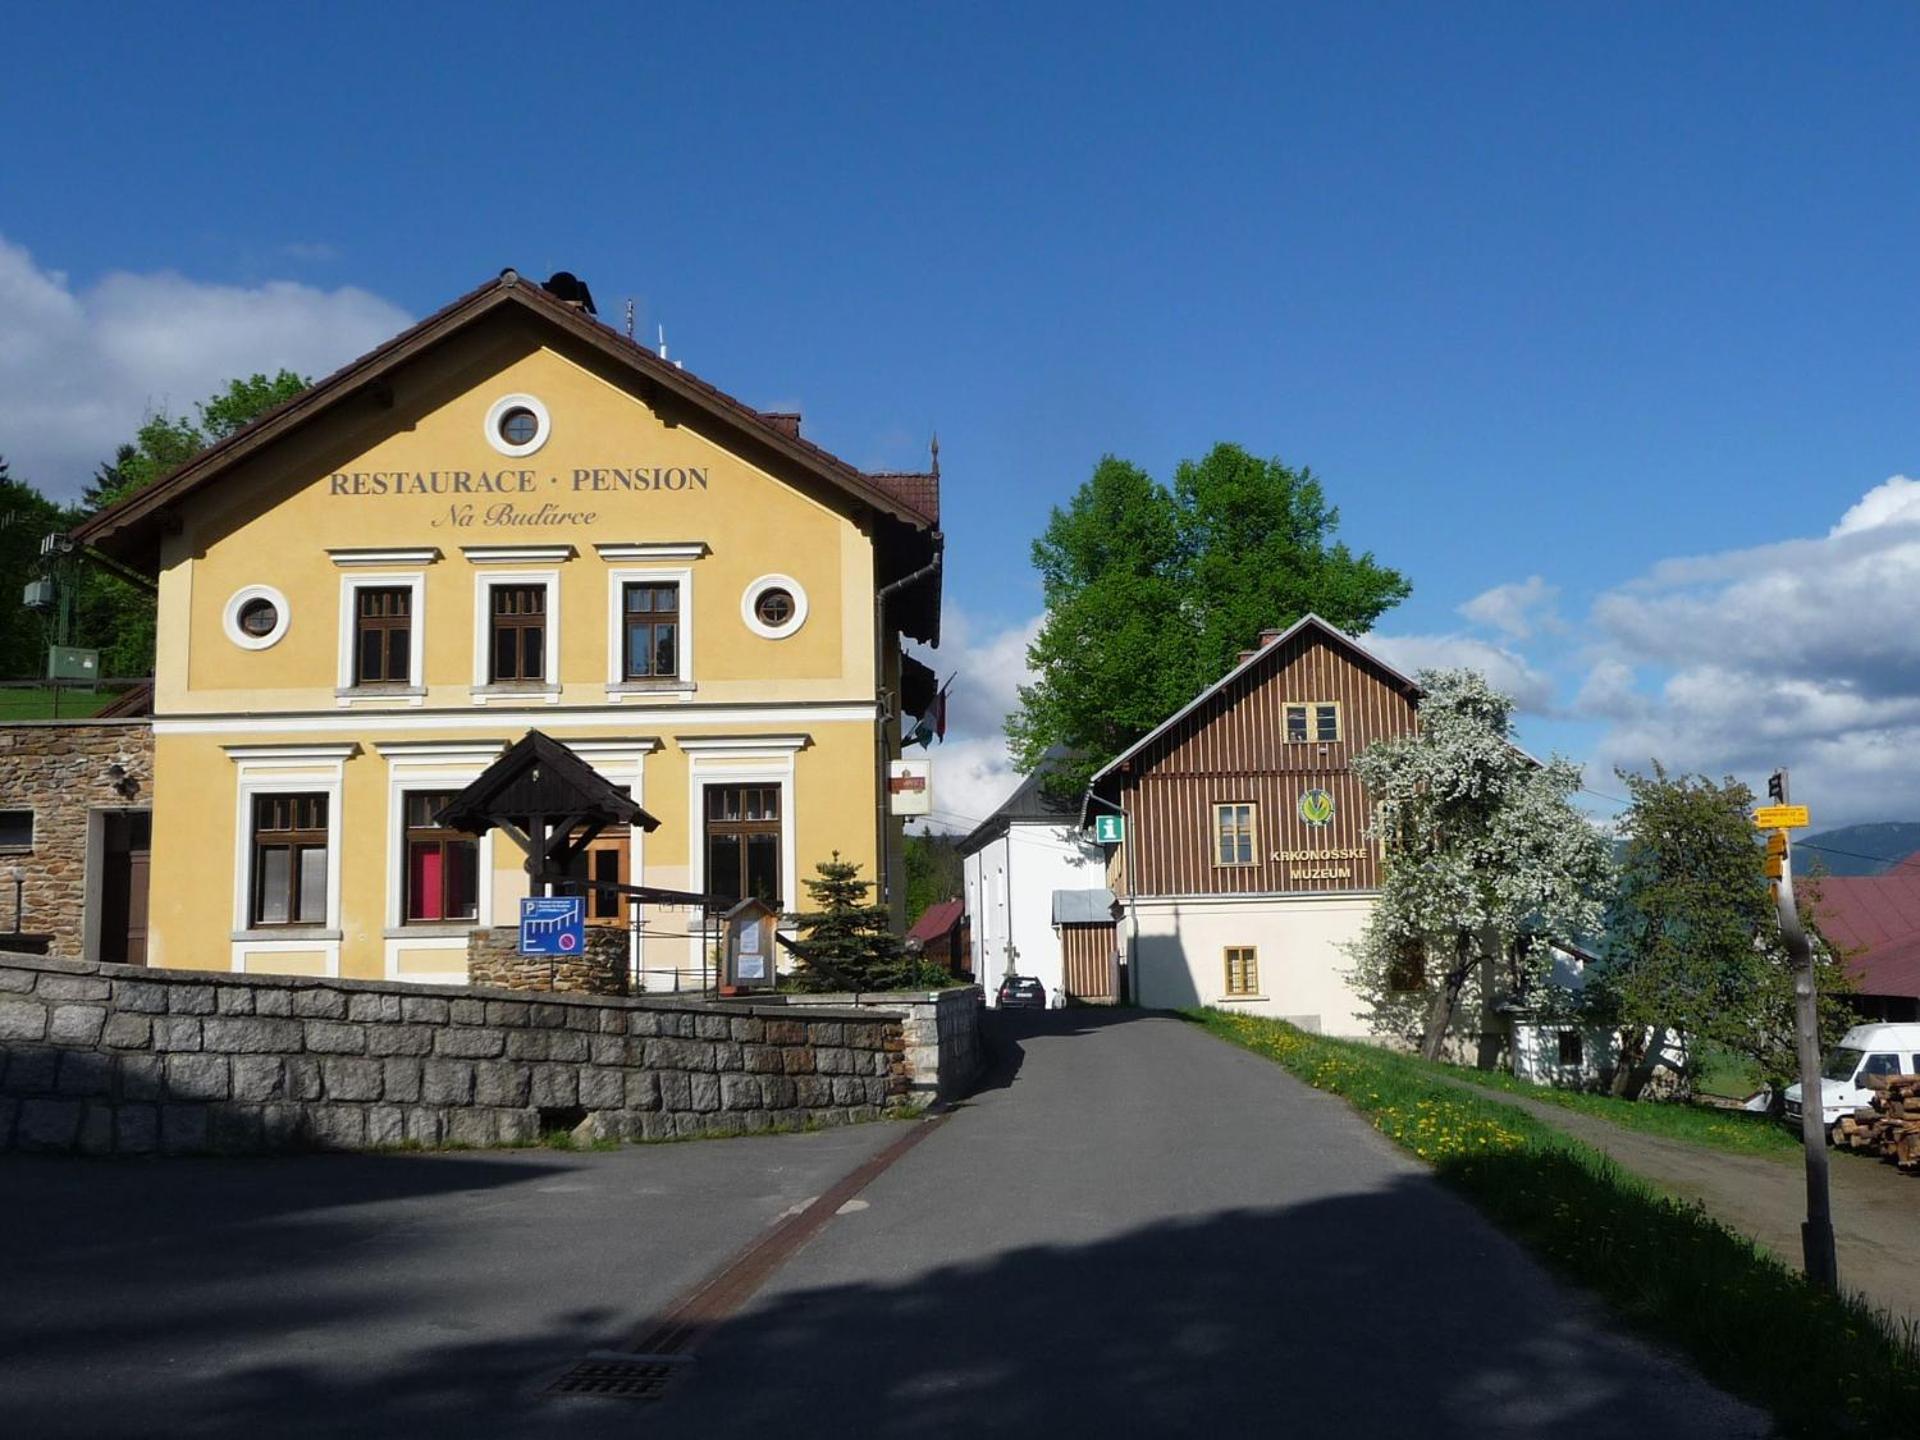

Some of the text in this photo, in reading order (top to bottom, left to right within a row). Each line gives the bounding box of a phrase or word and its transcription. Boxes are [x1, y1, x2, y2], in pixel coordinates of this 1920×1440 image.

[328, 467, 709, 496] RESTAURACE PENSION
[430, 503, 474, 528] Na
[1290, 868, 1351, 879] MUZEUM
[526, 903, 535, 915] P
